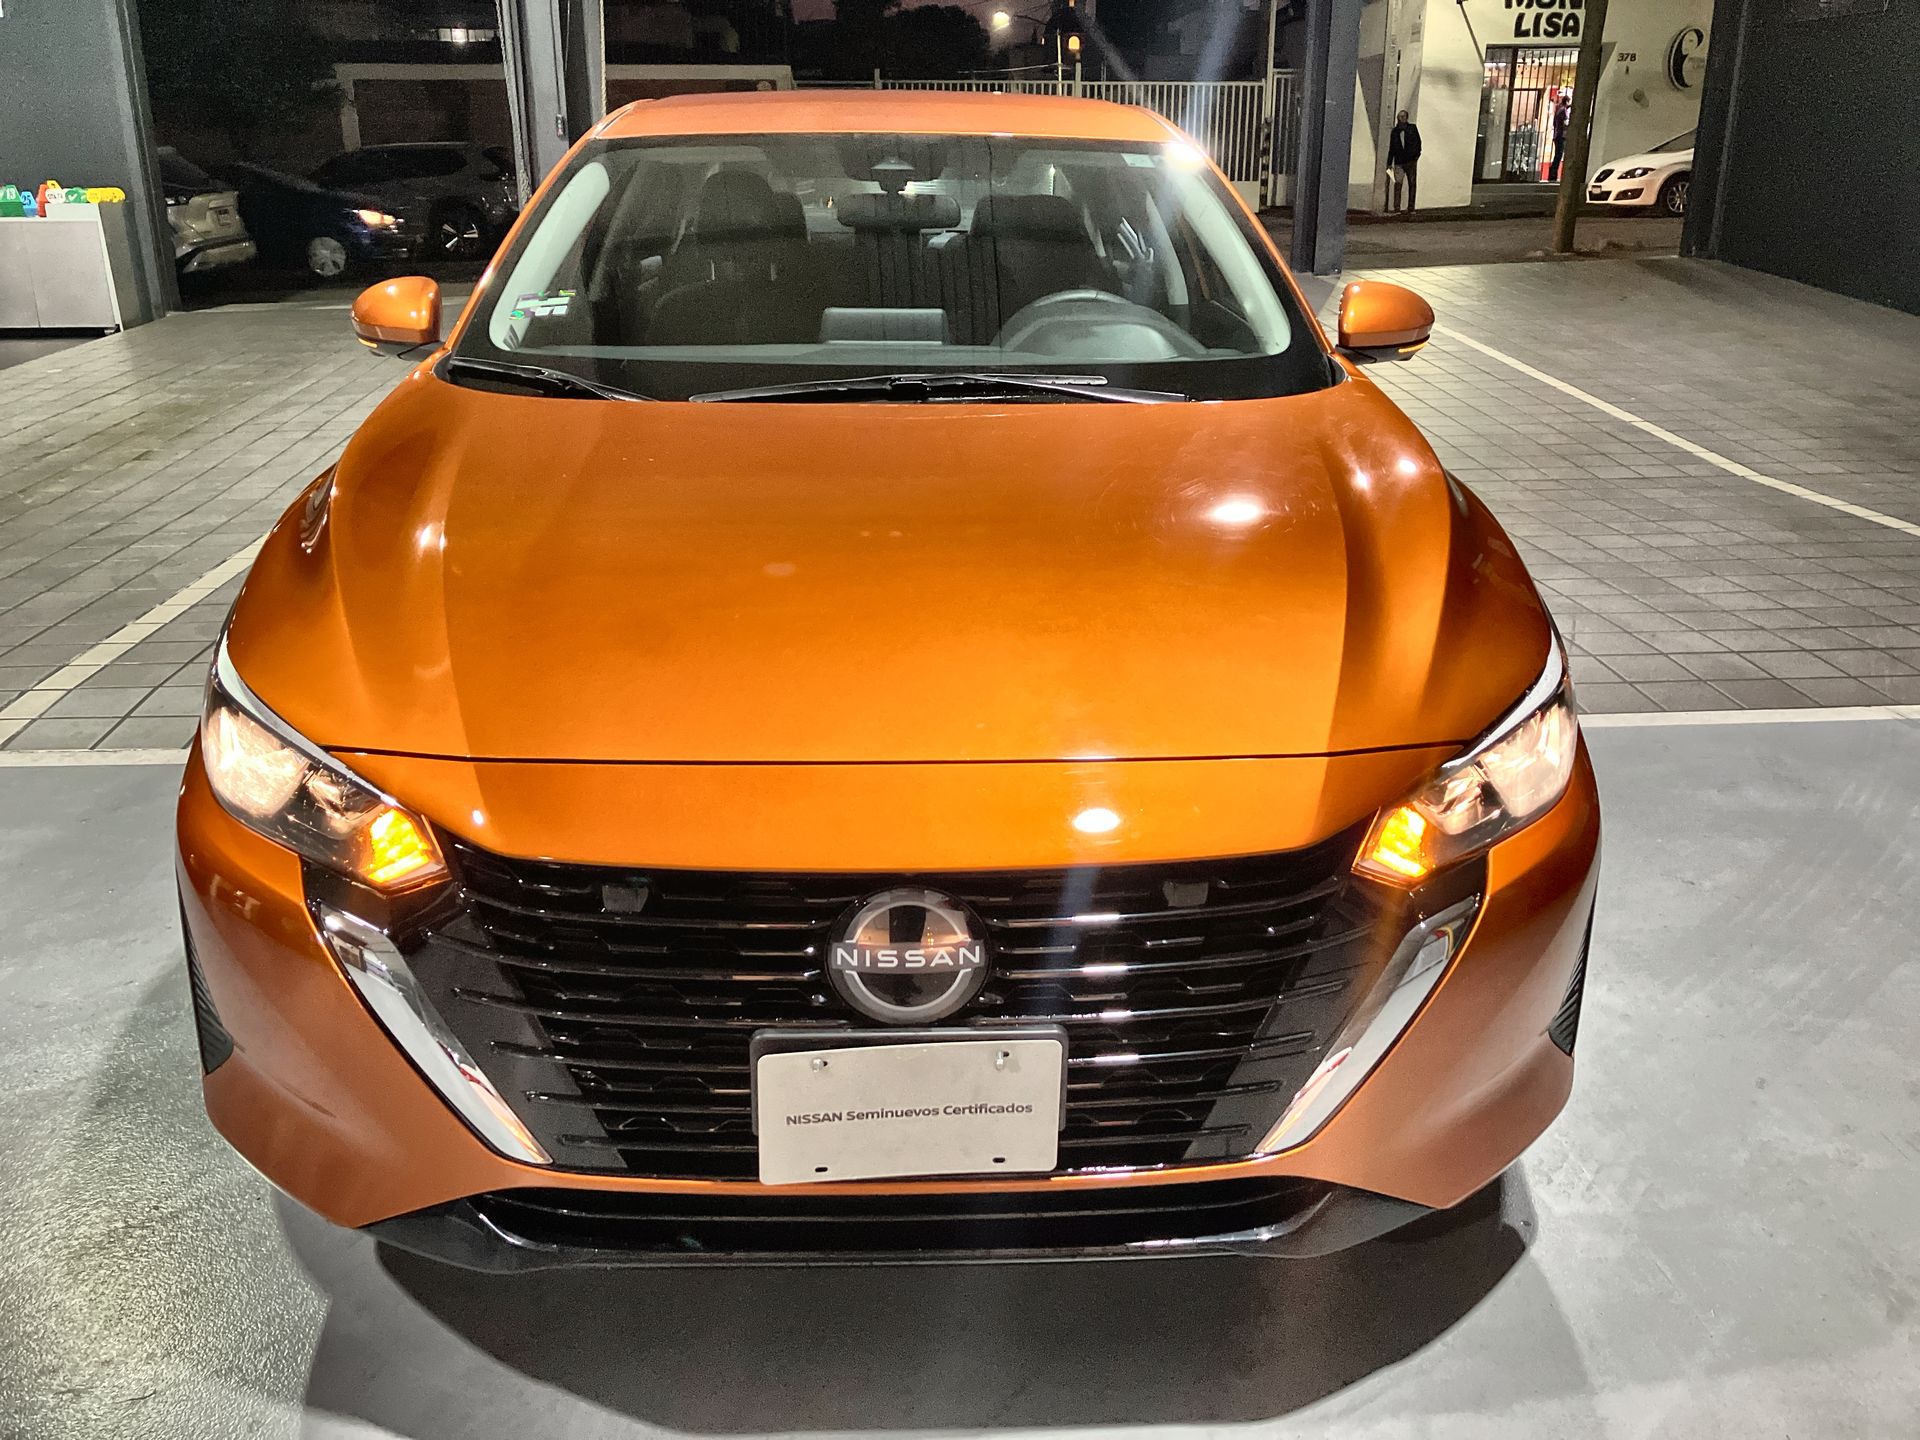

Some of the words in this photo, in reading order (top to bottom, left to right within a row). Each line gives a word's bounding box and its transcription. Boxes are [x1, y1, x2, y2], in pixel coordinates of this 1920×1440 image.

[1514, 12, 1580, 38] LISA
[1617, 52, 1637, 62] 378
[836, 945, 980, 968] NISSAN
[786, 1111, 843, 1126] NISSAN
[846, 1106, 940, 1121] Seminuevos
[943, 1103, 1033, 1116] Certificados
